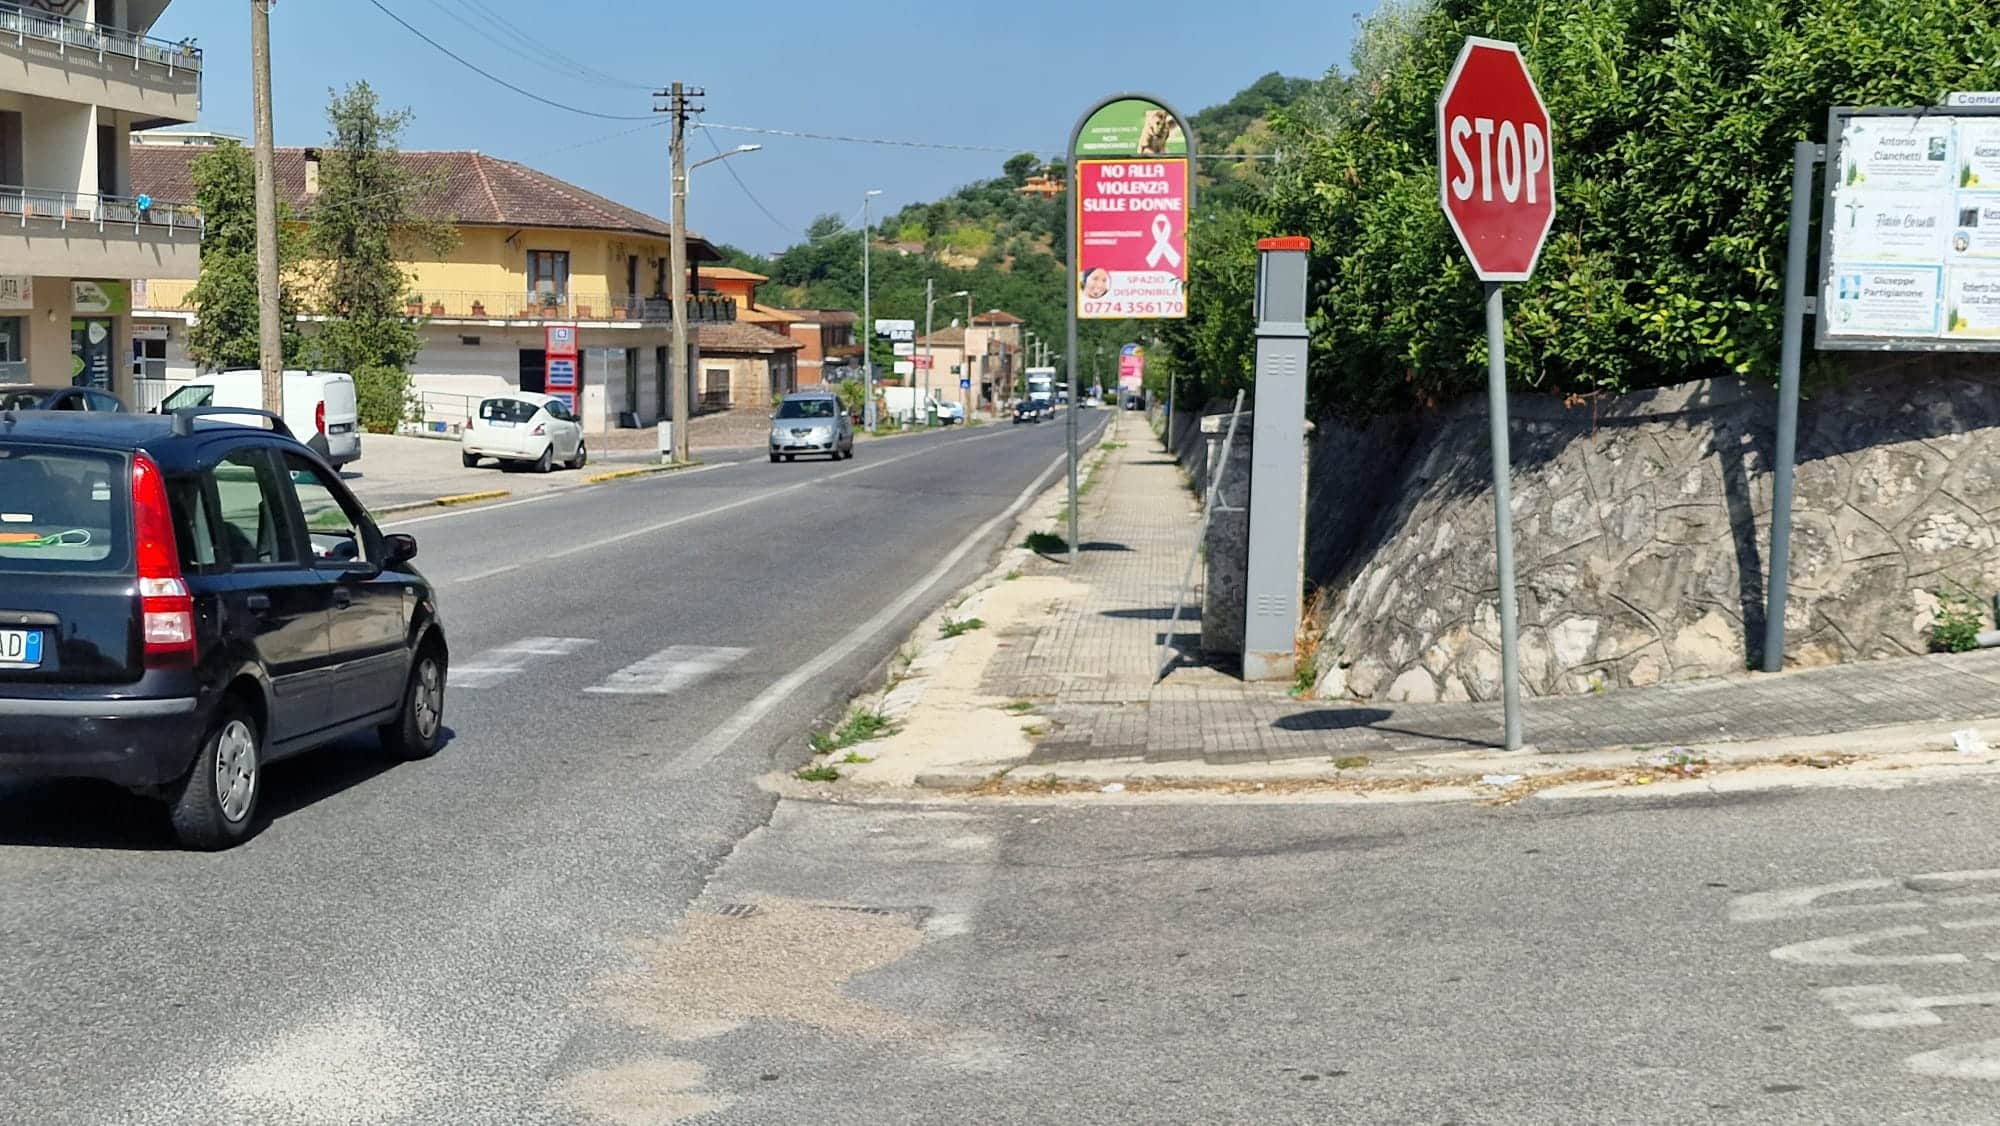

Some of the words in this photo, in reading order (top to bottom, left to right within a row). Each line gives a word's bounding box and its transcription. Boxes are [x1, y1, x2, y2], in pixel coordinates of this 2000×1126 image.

[1450, 115, 1545, 204] STOP
[1101, 165, 1125, 178] NO
[1128, 164, 1165, 178] ALLA
[1096, 181, 1169, 195] VIOLENZA
[1083, 198, 1126, 212] SULLE
[1129, 197, 1182, 211] DONNE
[1127, 276, 1165, 284] SPAZIO
[1874, 276, 1915, 286] Giuseppe
[1113, 288, 1178, 297] DISPONIBILE
[1084, 301, 1122, 313] 0774
[1127, 301, 1183, 313] 356170
